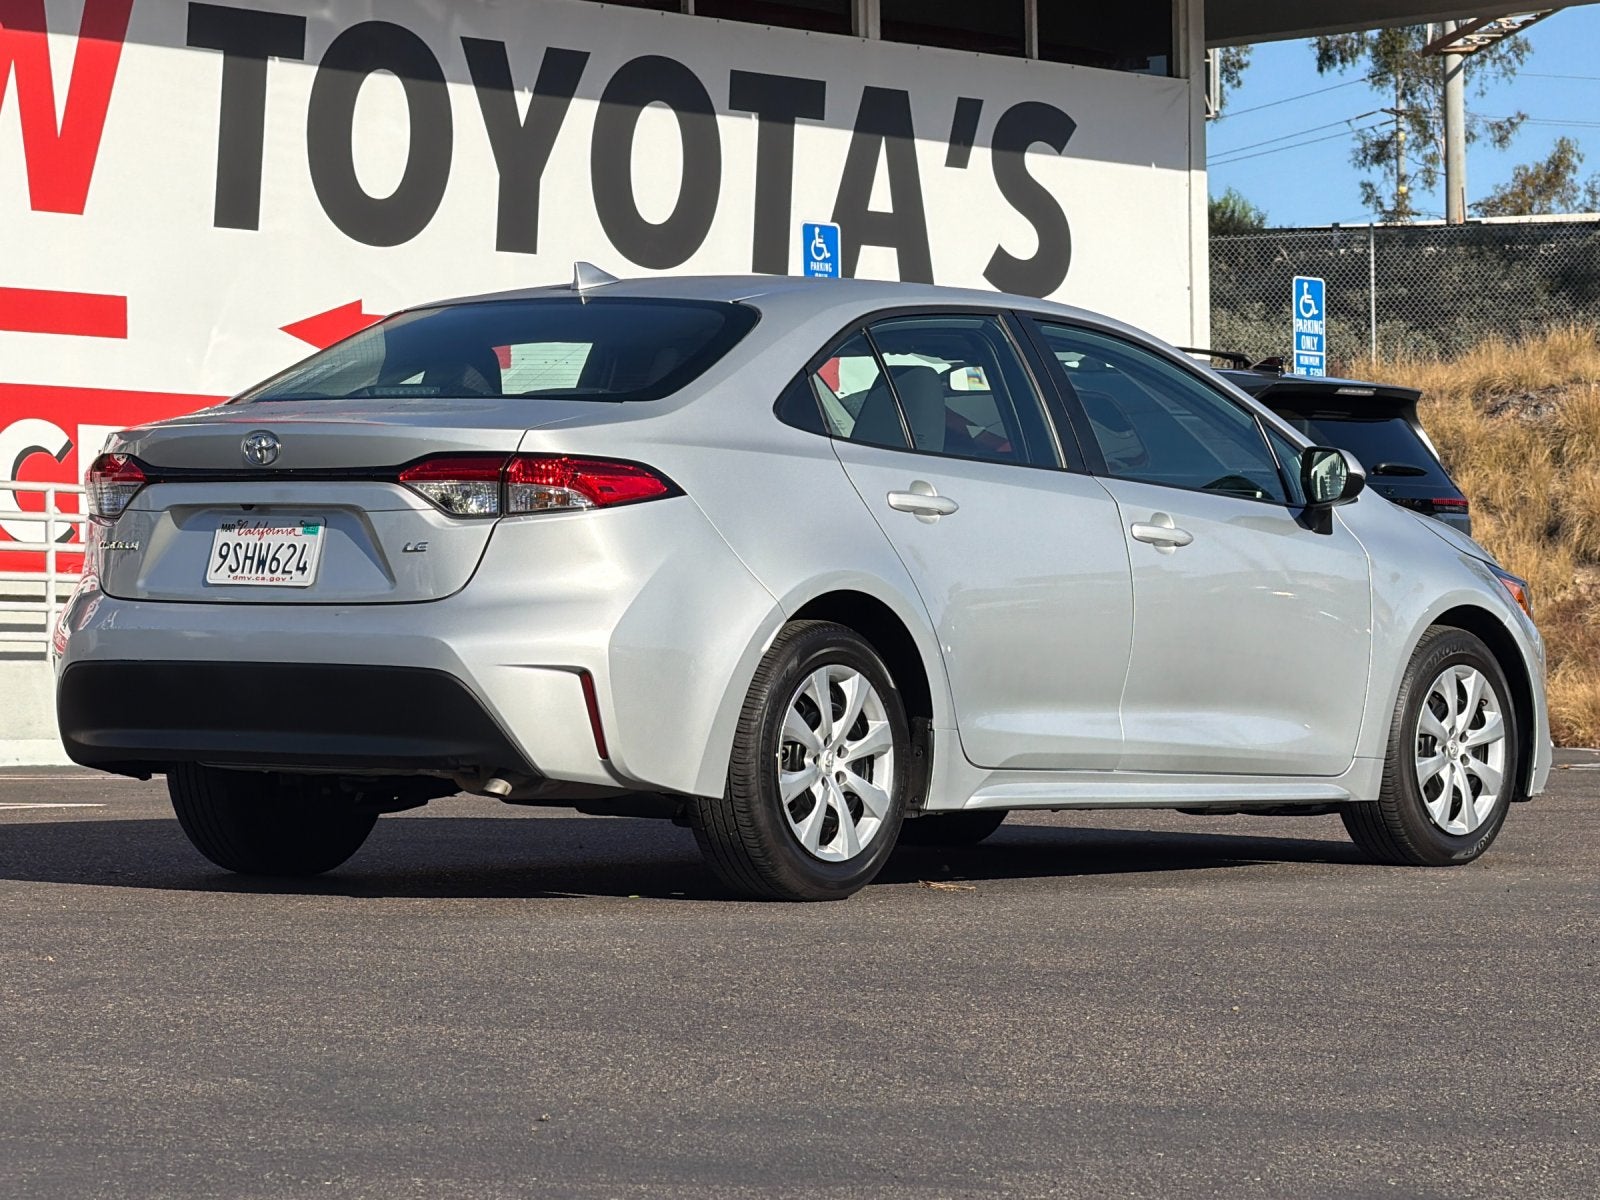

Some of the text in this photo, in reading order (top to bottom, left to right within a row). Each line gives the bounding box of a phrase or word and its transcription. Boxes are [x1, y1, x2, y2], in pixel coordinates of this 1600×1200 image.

[187, 2, 1077, 299] TOYOTA'S
[1295, 318, 1323, 335] PARKING
[1301, 335, 1318, 351] ONLY
[1299, 354, 1320, 366] MINIMUM
[237, 519, 302, 541] California
[401, 541, 429, 553] LE
[214, 541, 308, 576] 9SHW624
[232, 573, 287, 582] dmv.ca.gov
